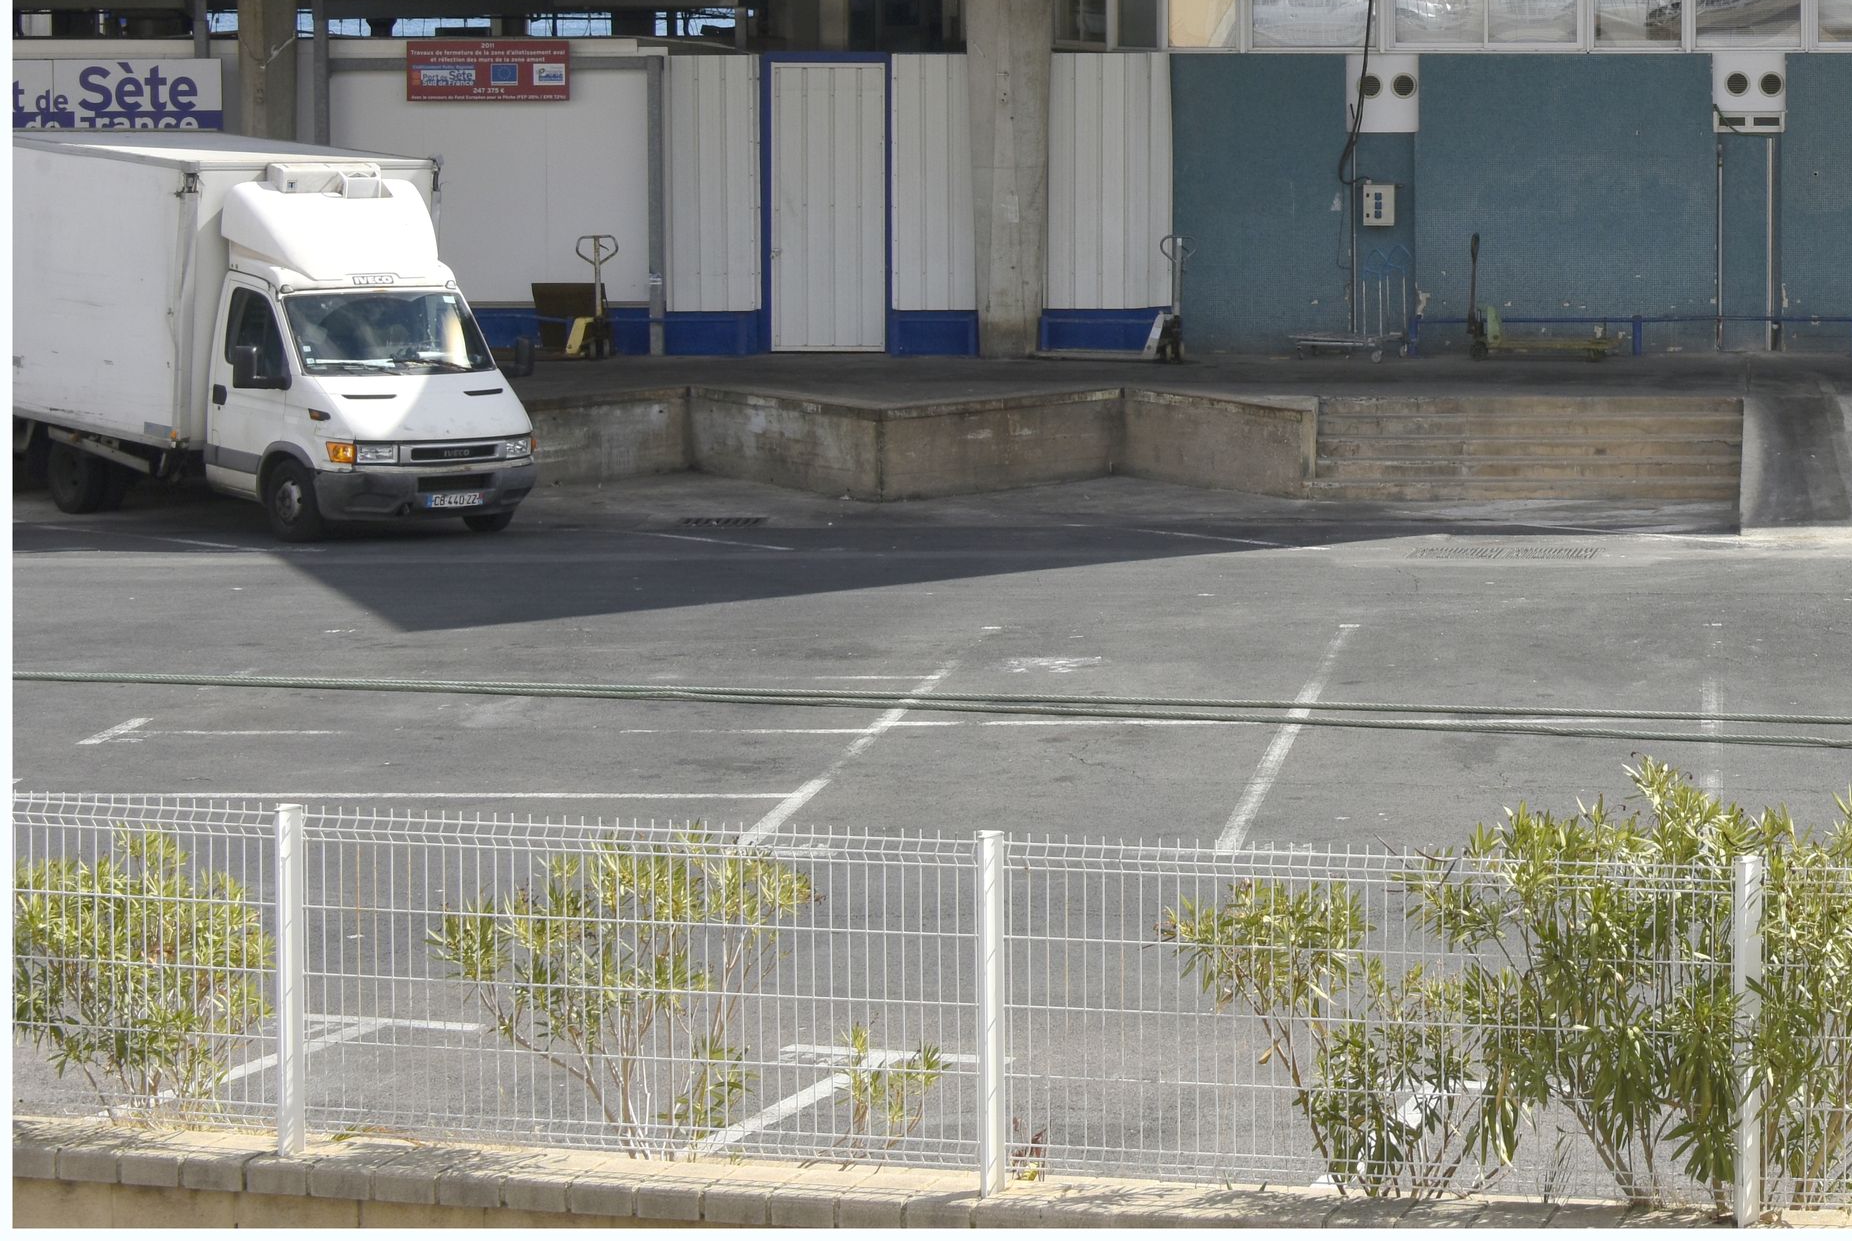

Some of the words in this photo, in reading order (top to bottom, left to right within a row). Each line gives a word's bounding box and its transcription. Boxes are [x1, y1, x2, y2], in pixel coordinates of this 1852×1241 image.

[449, 70, 472, 80] Sète
[36, 89, 69, 112] de
[78, 62, 198, 111] Sète
[353, 276, 394, 285] IVECO
[444, 448, 470, 457] IVECO
